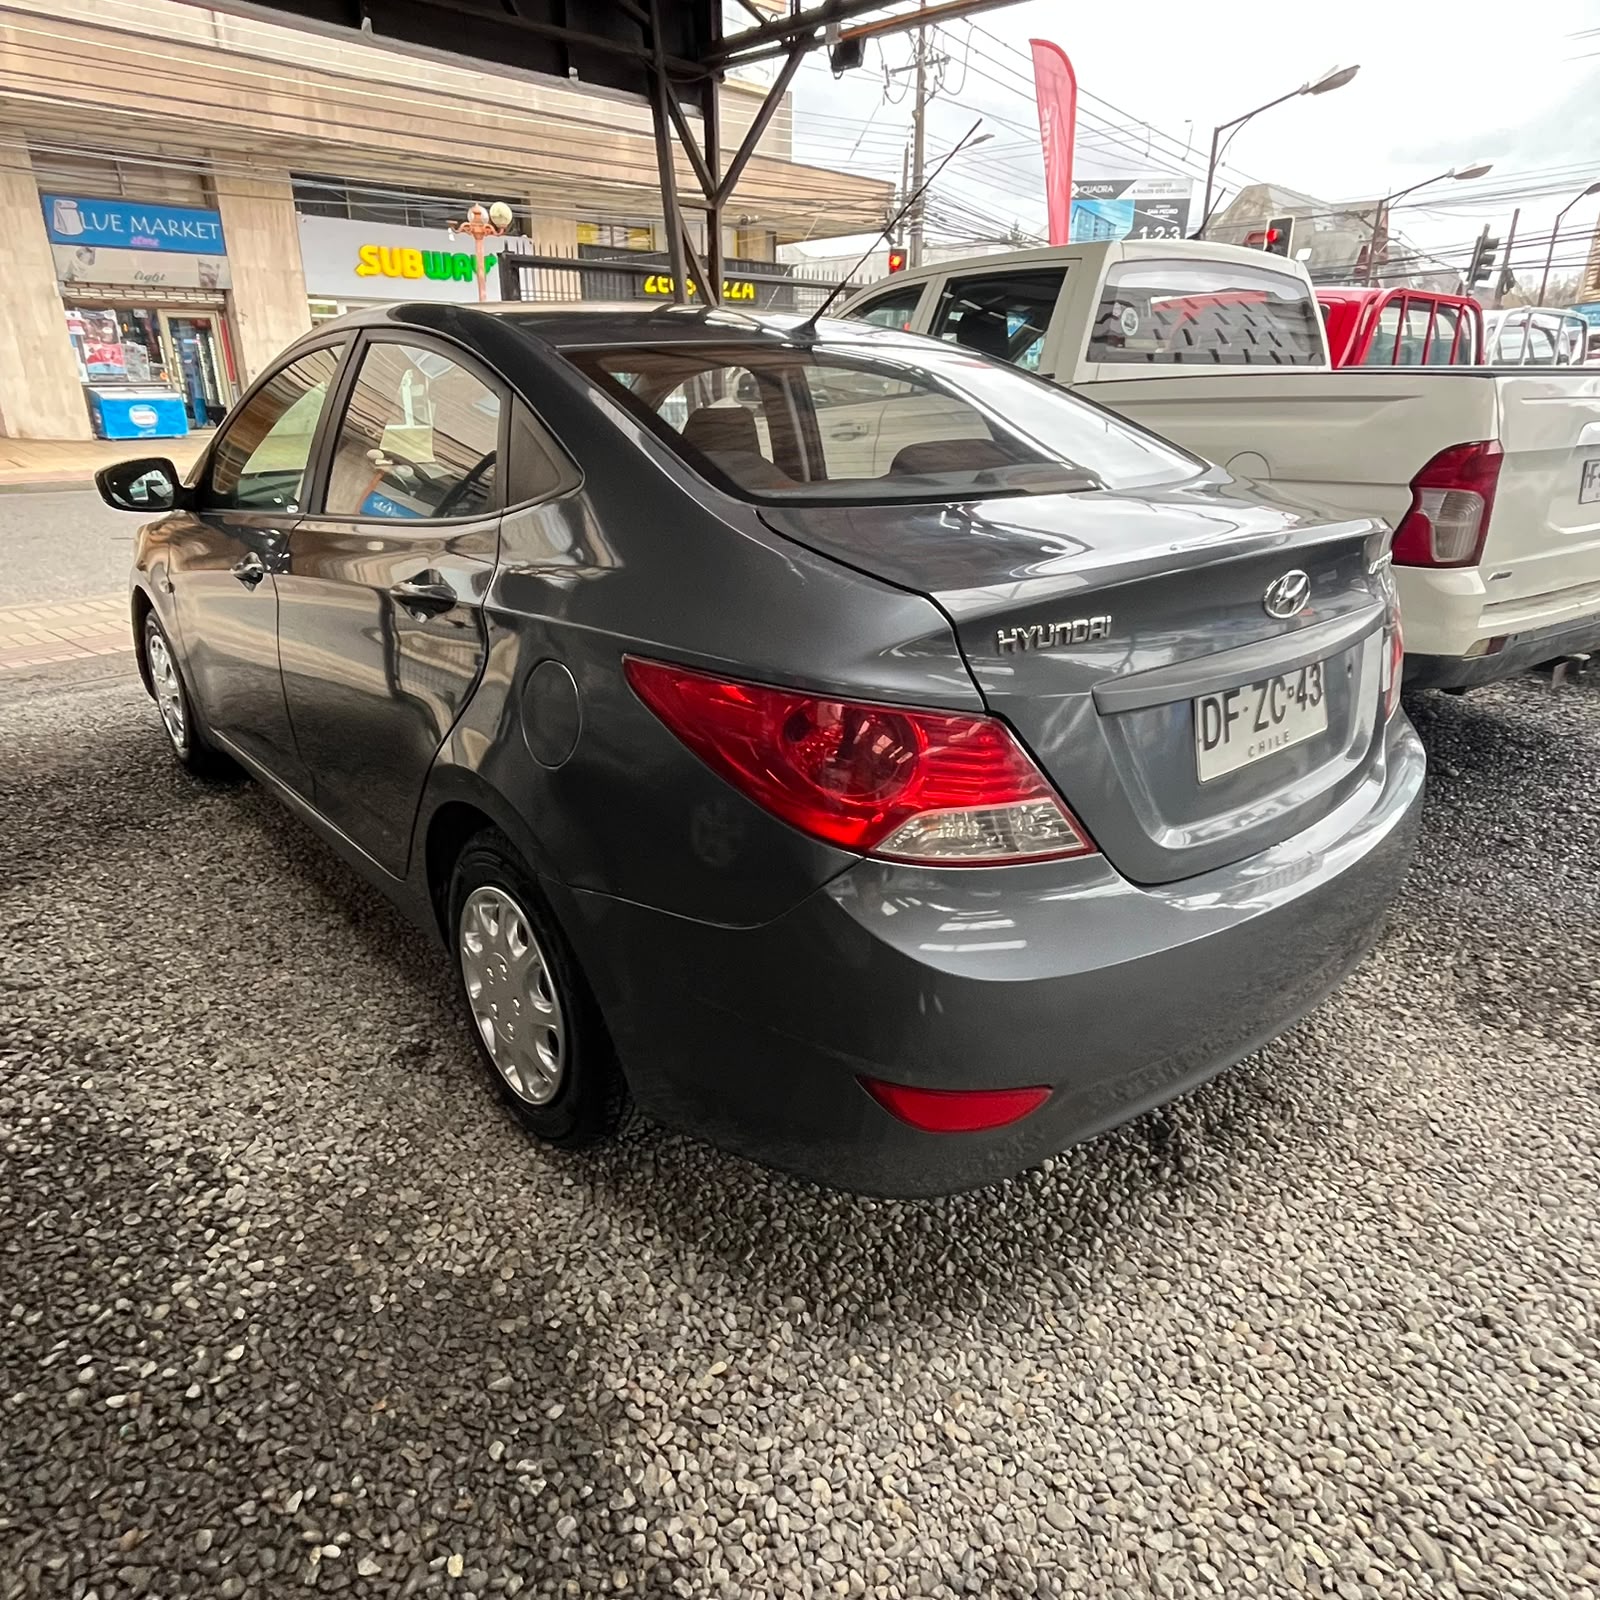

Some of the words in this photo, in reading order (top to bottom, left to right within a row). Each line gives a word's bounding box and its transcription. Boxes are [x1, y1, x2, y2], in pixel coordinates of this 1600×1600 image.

[130, 215, 220, 240] MARKET
[996, 615, 1112, 655] HYUNDAI
[1247, 730, 1290, 758] CHILE
